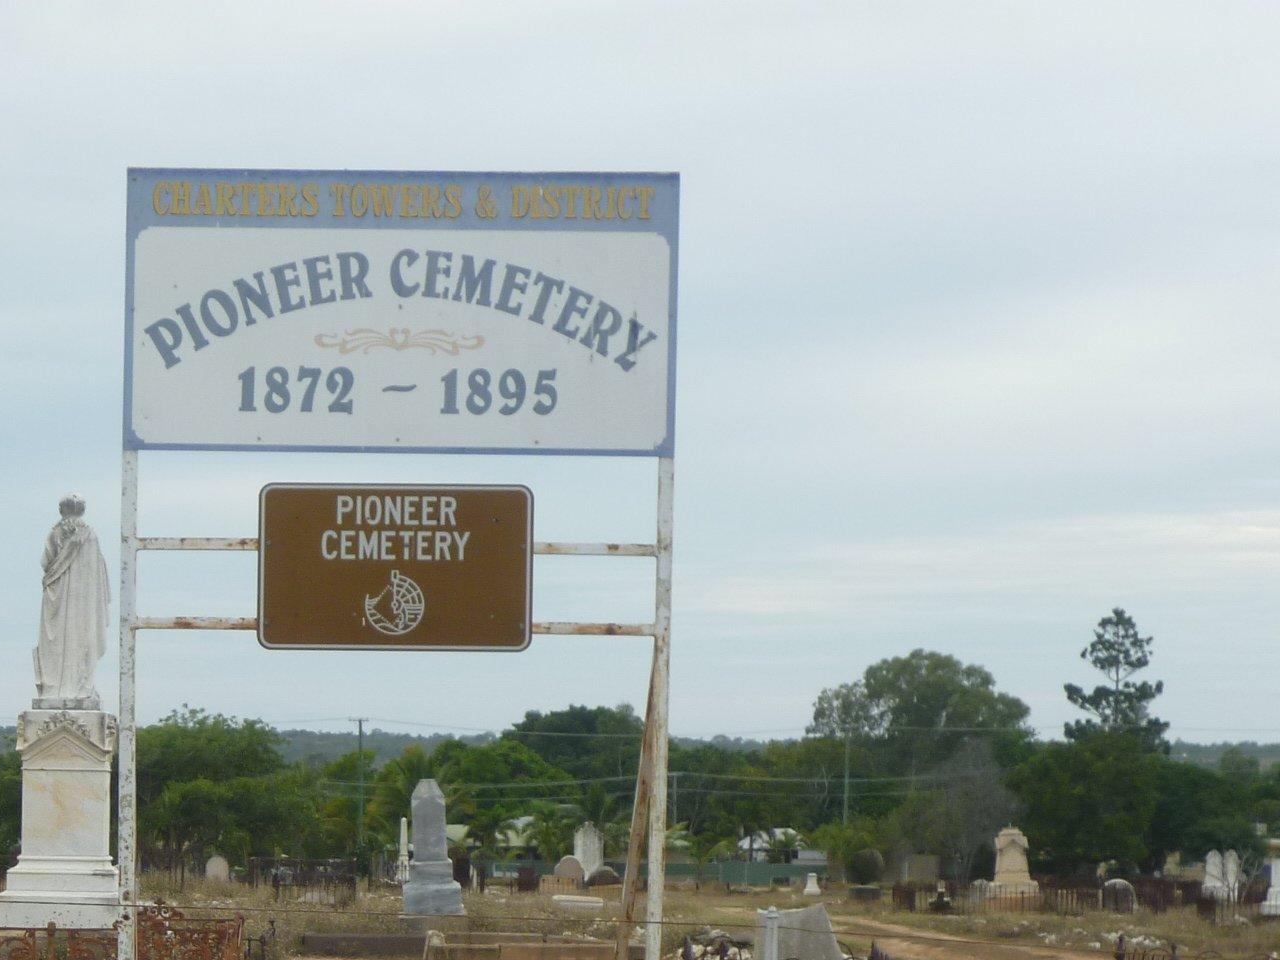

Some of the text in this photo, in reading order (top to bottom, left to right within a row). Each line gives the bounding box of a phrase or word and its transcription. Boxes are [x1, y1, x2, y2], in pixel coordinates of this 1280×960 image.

[152, 180, 655, 221] CHARTERS TOWERS & DISTRICT
[144, 248, 658, 372] PIONEER CEMETERY
[238, 366, 354, 414] 1872
[440, 368, 557, 416] 1895
[336, 495, 457, 525] PIONEER
[321, 530, 470, 561] CEMETERY
